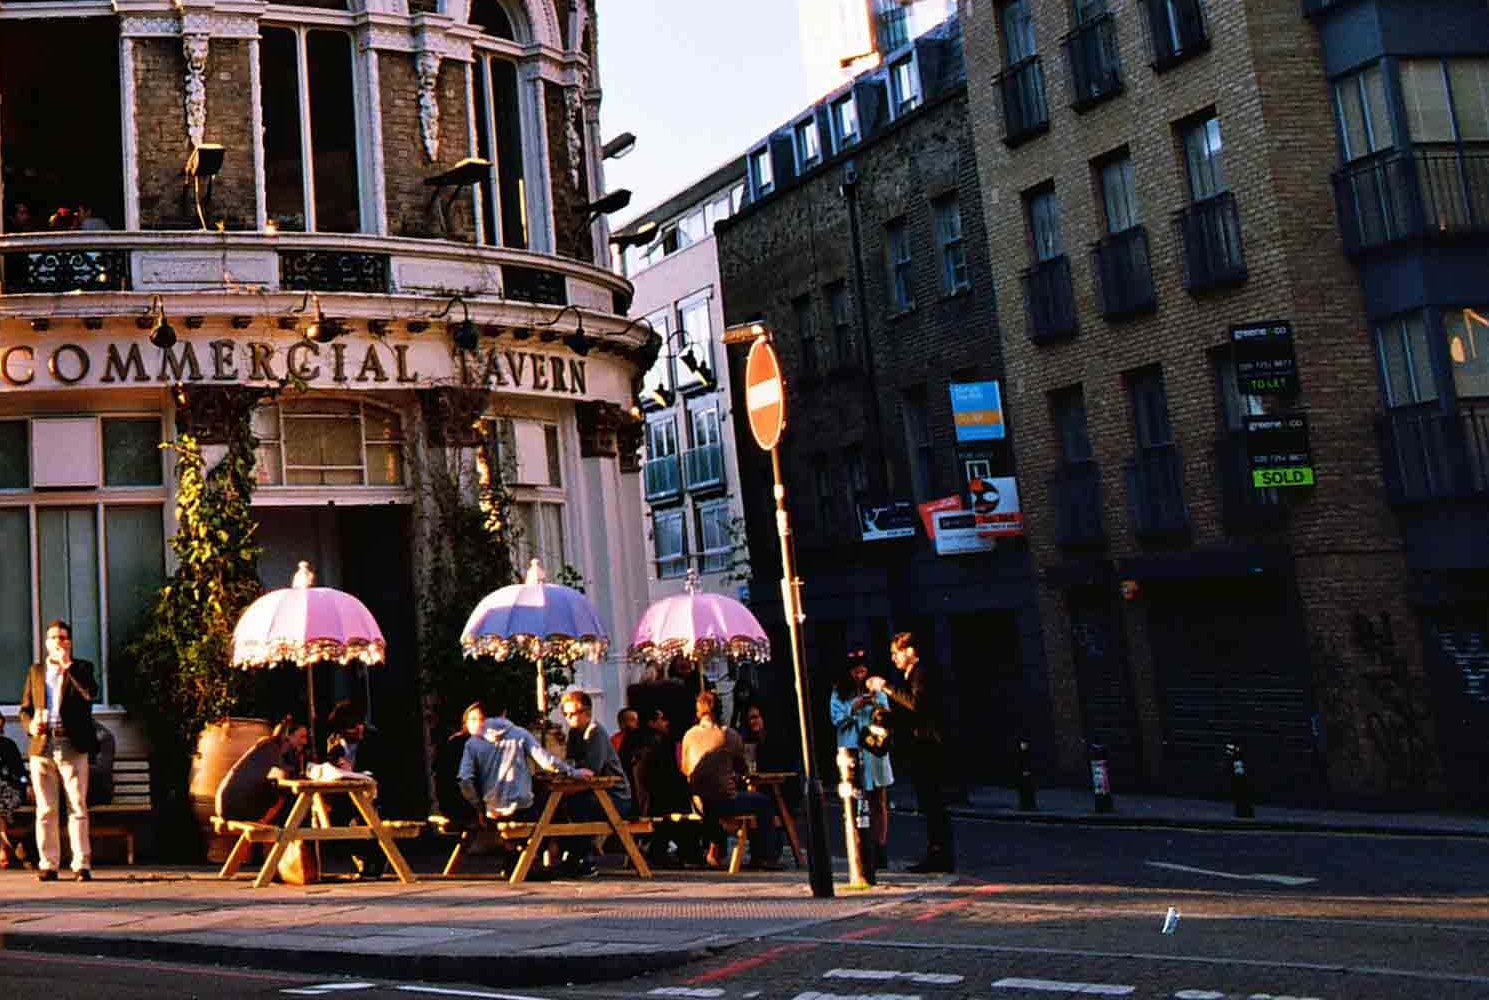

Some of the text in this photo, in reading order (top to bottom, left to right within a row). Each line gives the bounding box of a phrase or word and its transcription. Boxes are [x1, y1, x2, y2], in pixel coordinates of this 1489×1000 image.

[0, 341, 587, 396] COMMERCIAL TAVERN
[1262, 470, 1305, 485] SOLD
